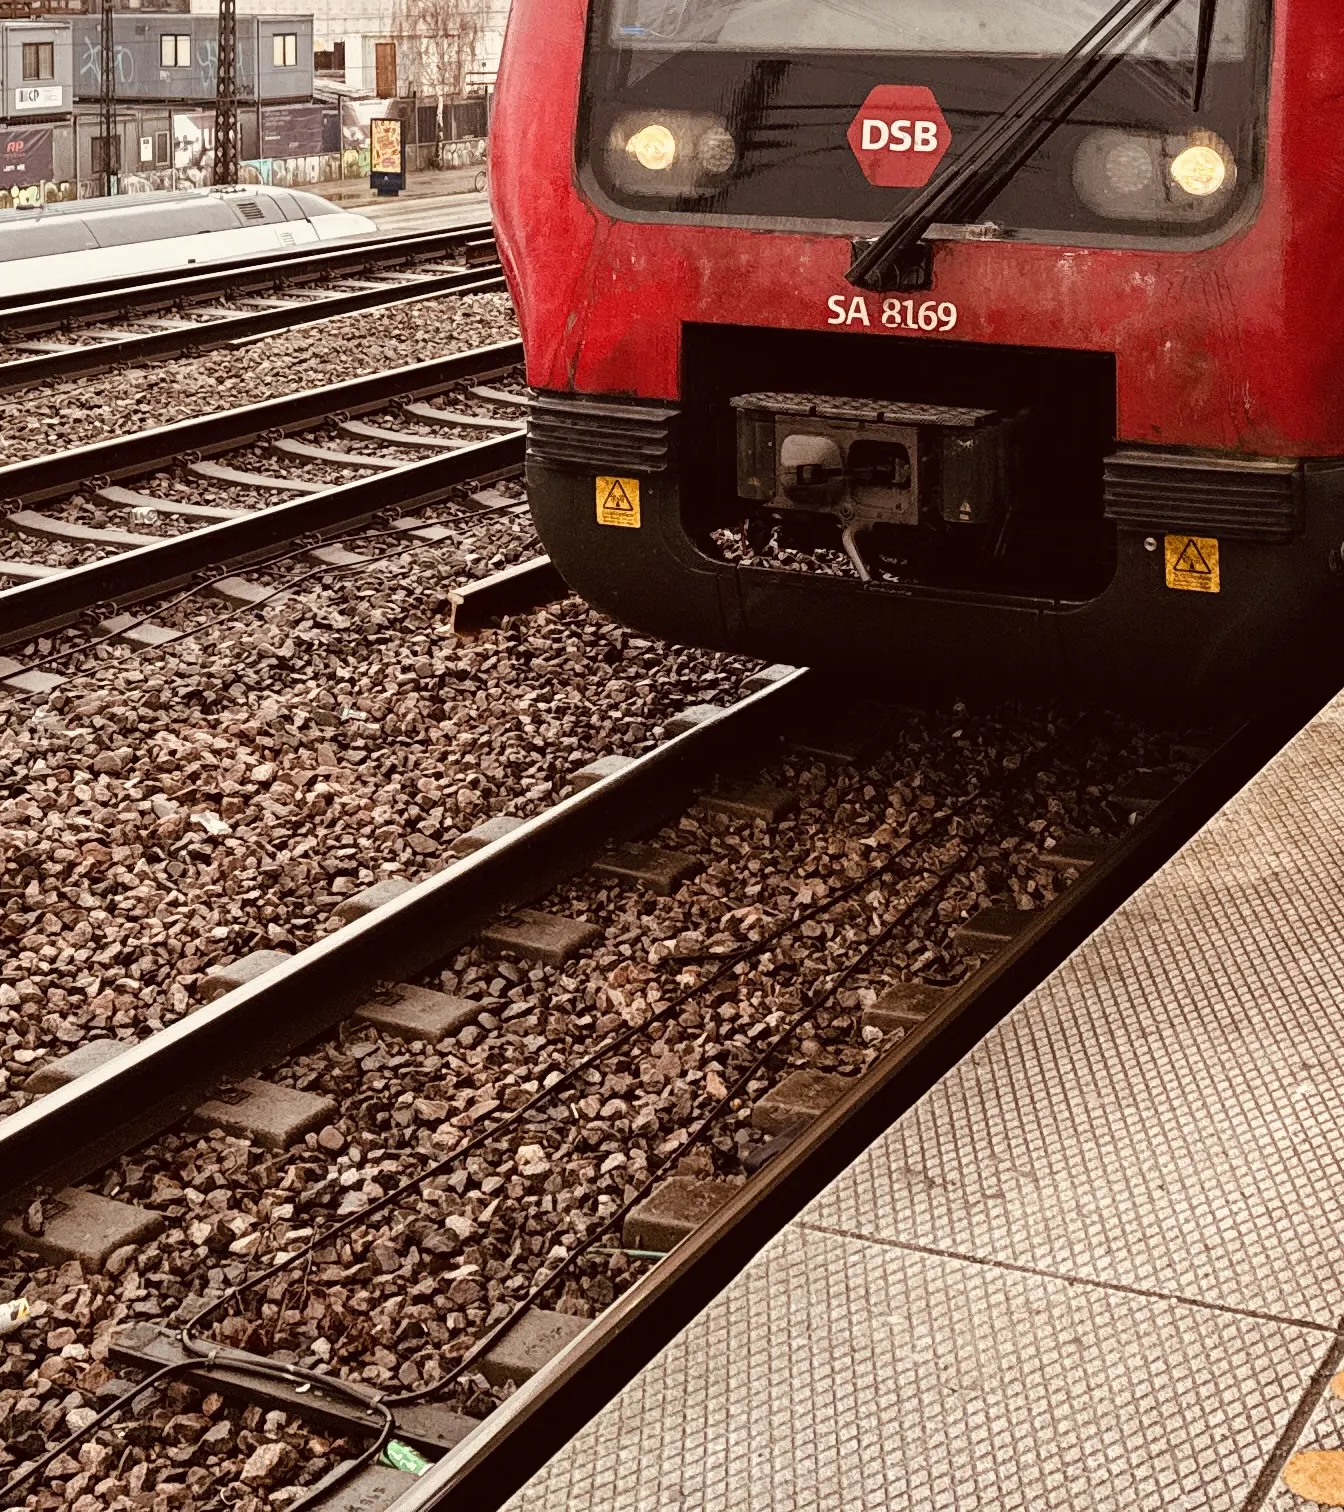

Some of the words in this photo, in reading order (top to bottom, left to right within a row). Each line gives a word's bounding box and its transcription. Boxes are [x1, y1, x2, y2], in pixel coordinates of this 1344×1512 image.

[861, 119, 938, 152] DSB
[827, 294, 871, 326] SA
[881, 298, 958, 331] 8169
